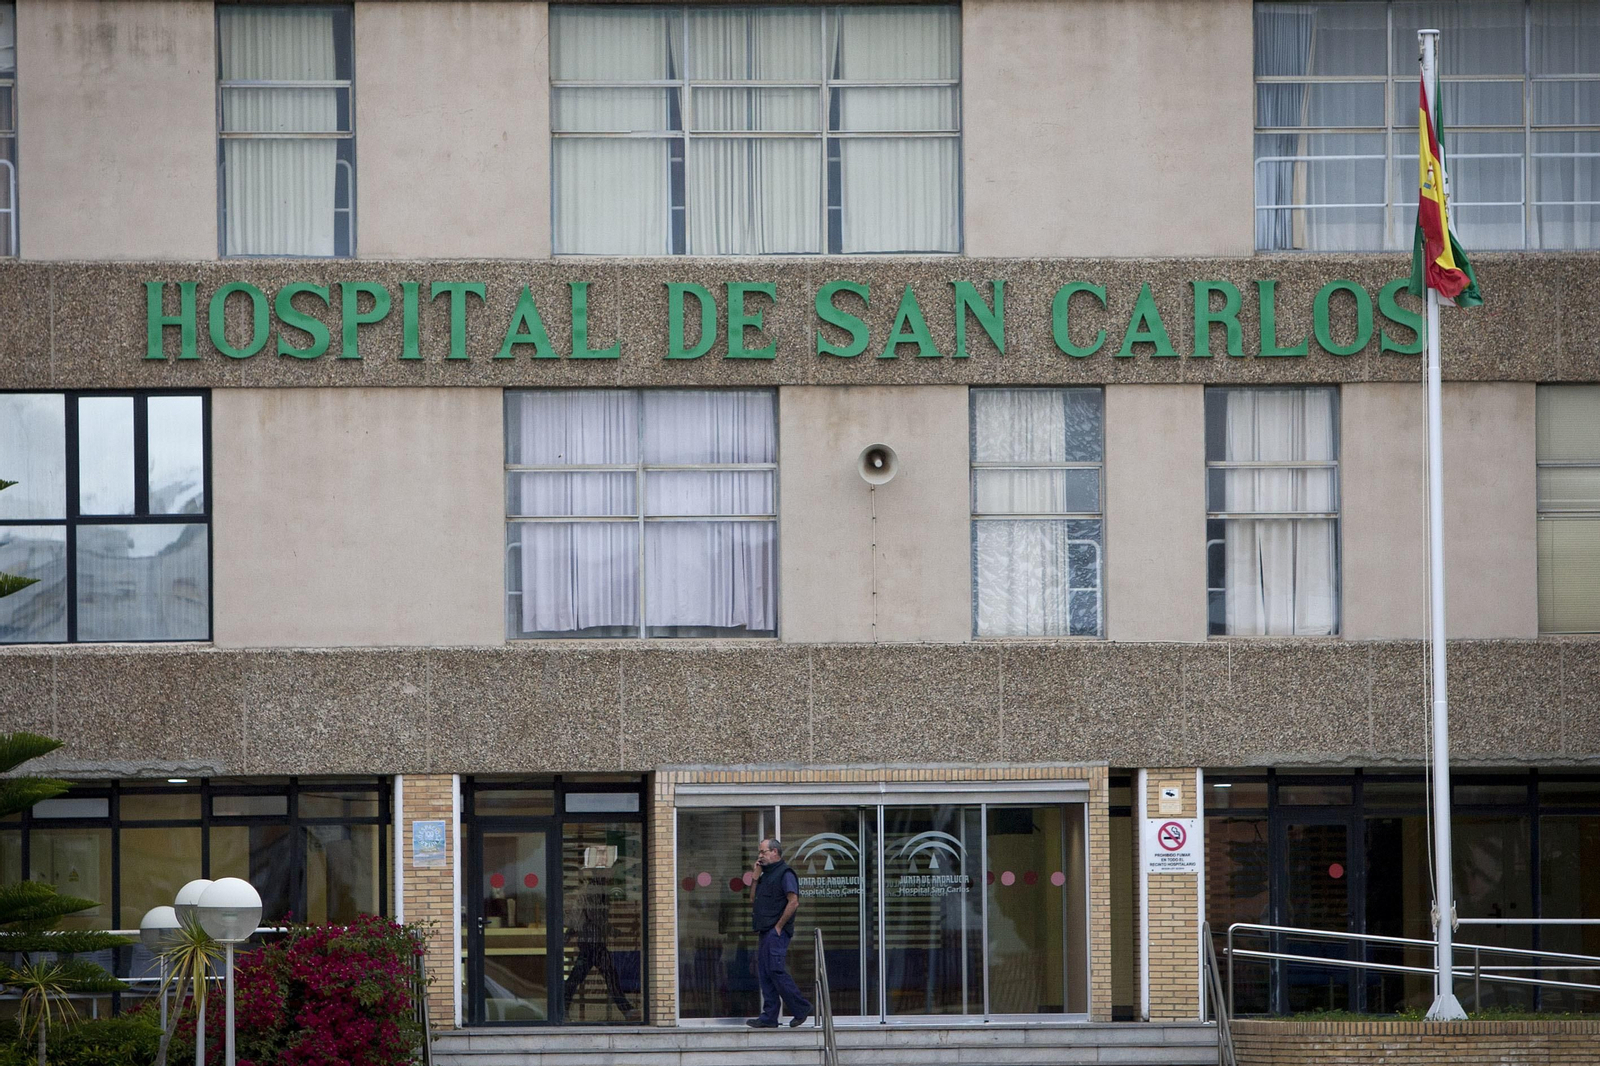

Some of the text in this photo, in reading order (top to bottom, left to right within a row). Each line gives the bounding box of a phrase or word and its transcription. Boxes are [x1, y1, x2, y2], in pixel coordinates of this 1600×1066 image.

[144, 278, 1428, 361] HOSPITAL DE SAN CARLOS
[799, 877, 816, 885] UNTA
[816, 877, 826, 885] DE
[900, 875, 920, 884] JUNTA
[921, 875, 931, 884] DE
[842, 887, 865, 895] Carlo
[899, 886, 930, 895] Hospital
[931, 886, 945, 894] San
